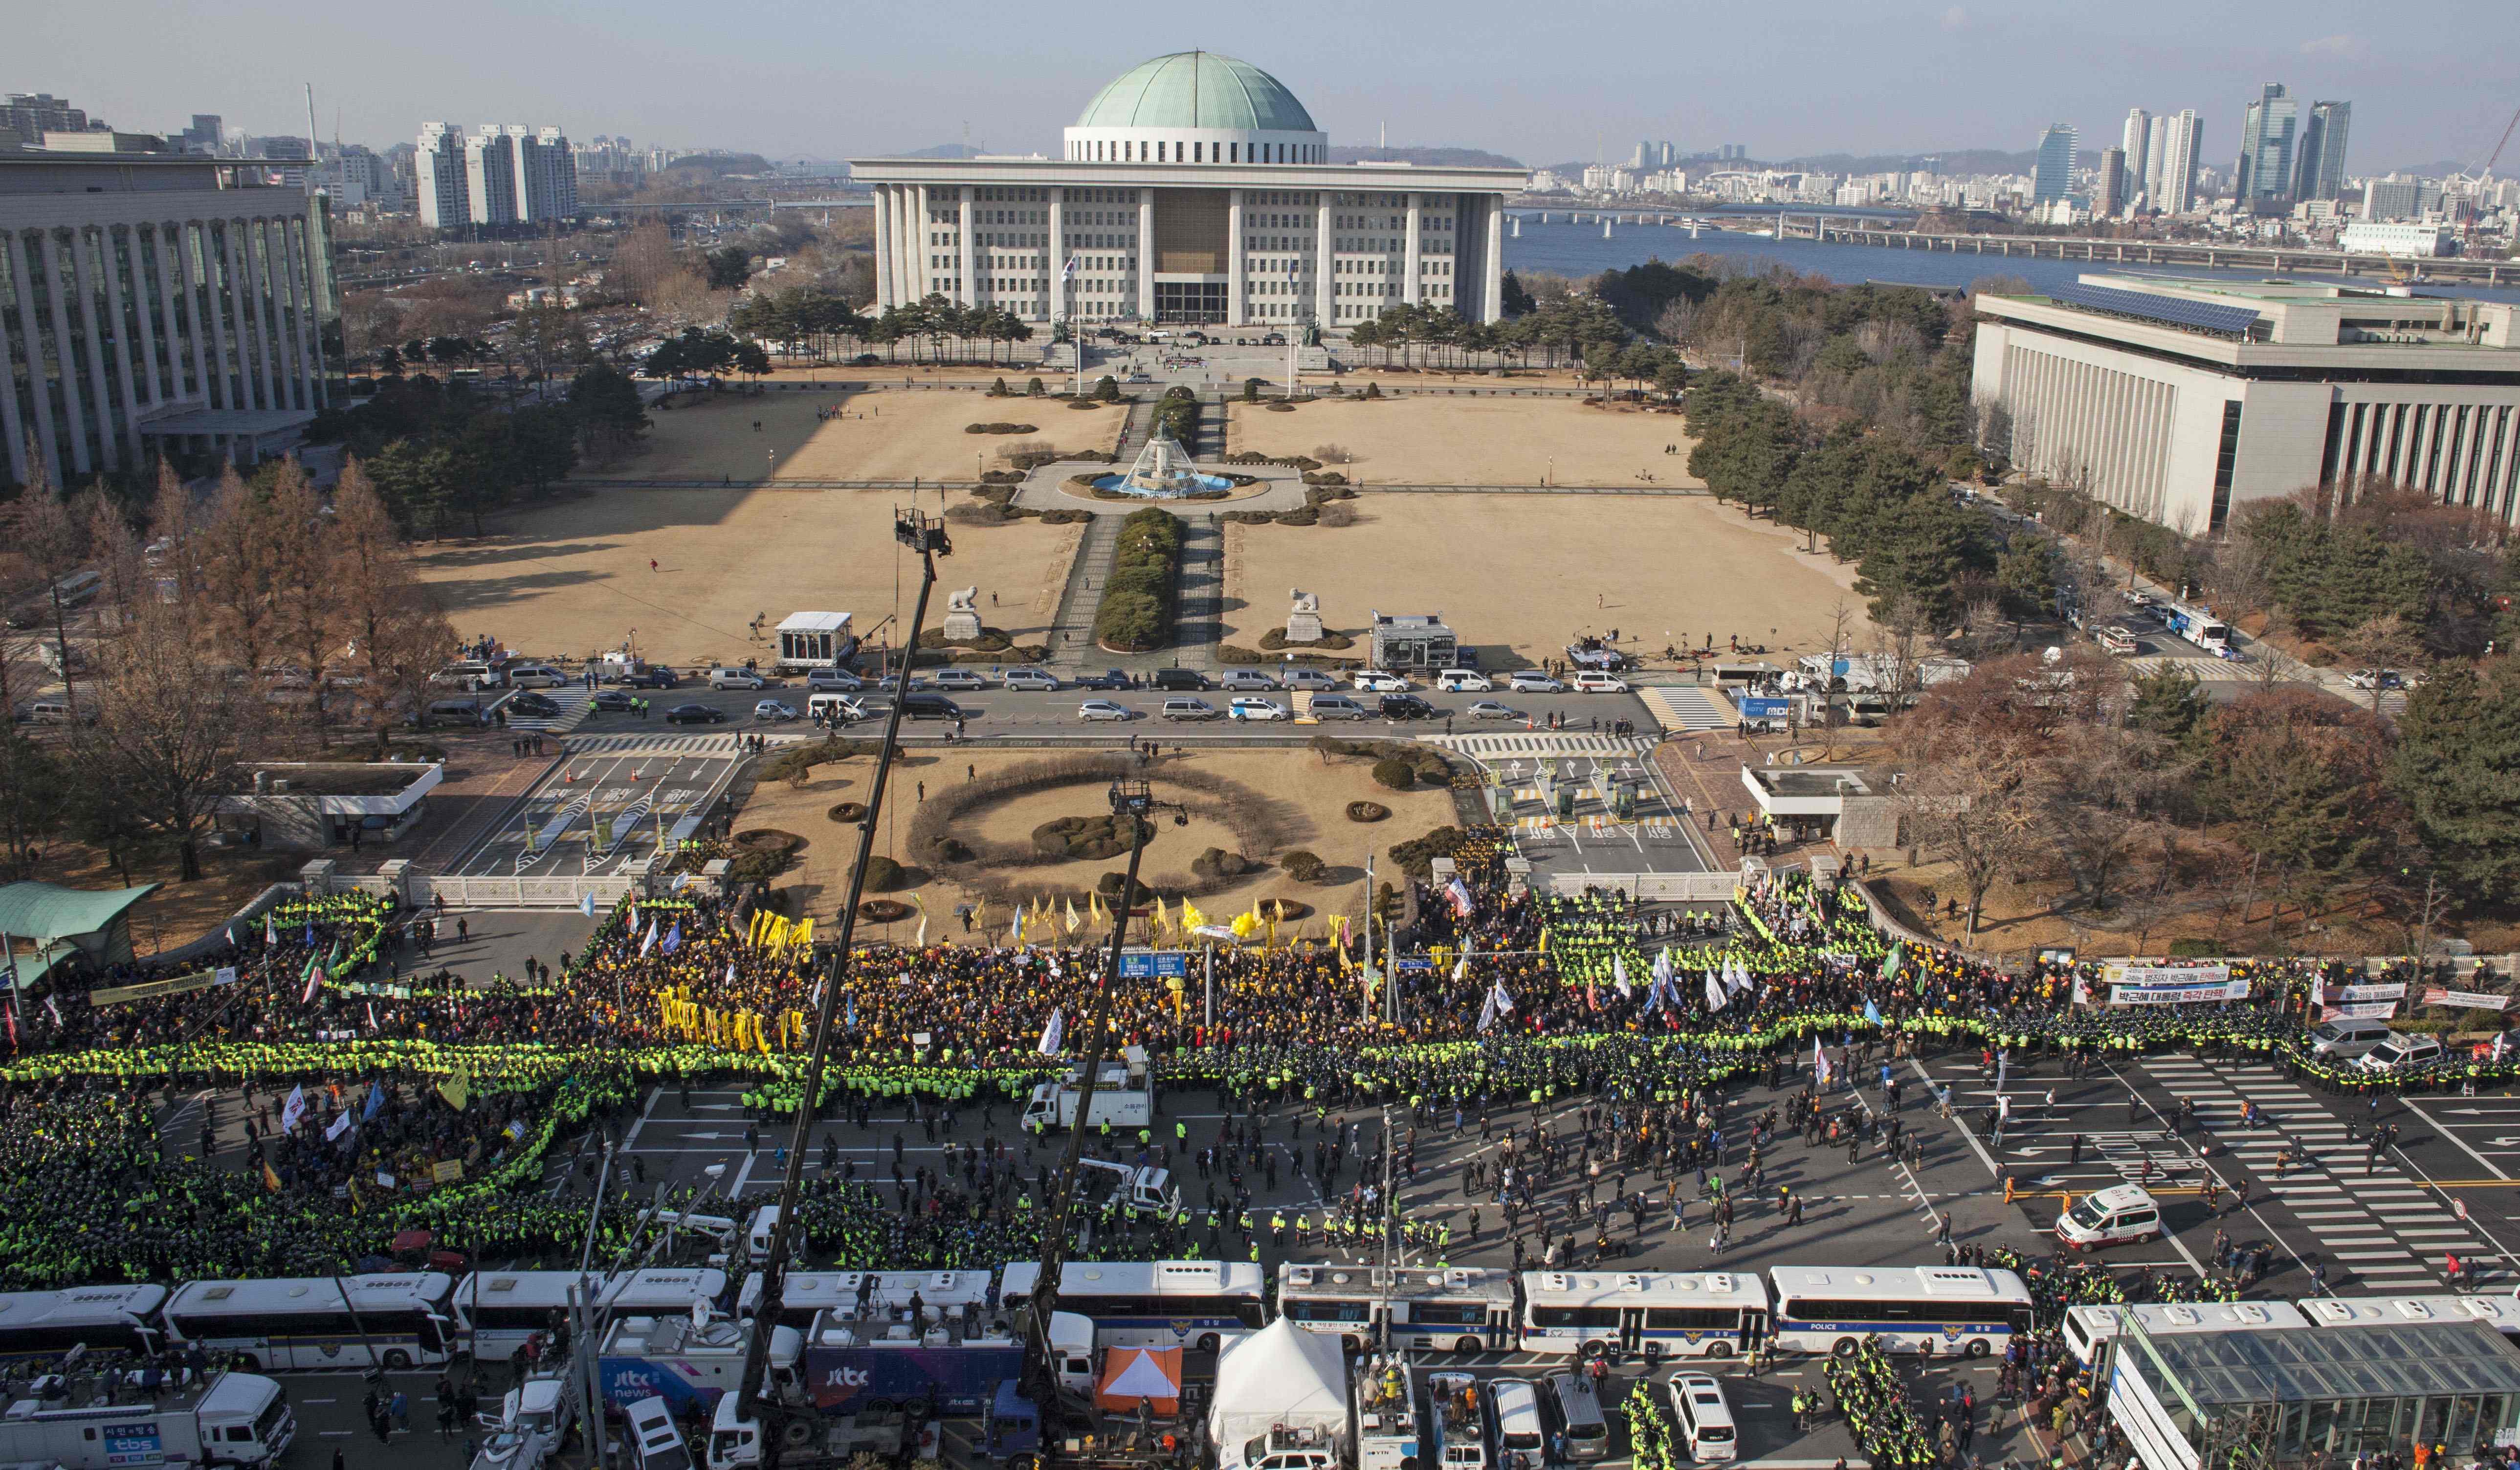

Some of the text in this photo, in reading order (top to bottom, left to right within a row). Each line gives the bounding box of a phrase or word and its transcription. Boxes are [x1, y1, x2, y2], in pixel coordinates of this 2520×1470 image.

[2144, 974, 2168, 982] 범죄자
[2119, 988, 2227, 1002] 박근혜 대통령 즉각 탄핵!
[2111, 1189, 2127, 1202] 119
[615, 1389, 651, 1397] news
[135, 1425, 156, 1435] 방송
[114, 1439, 153, 1450] tbs
